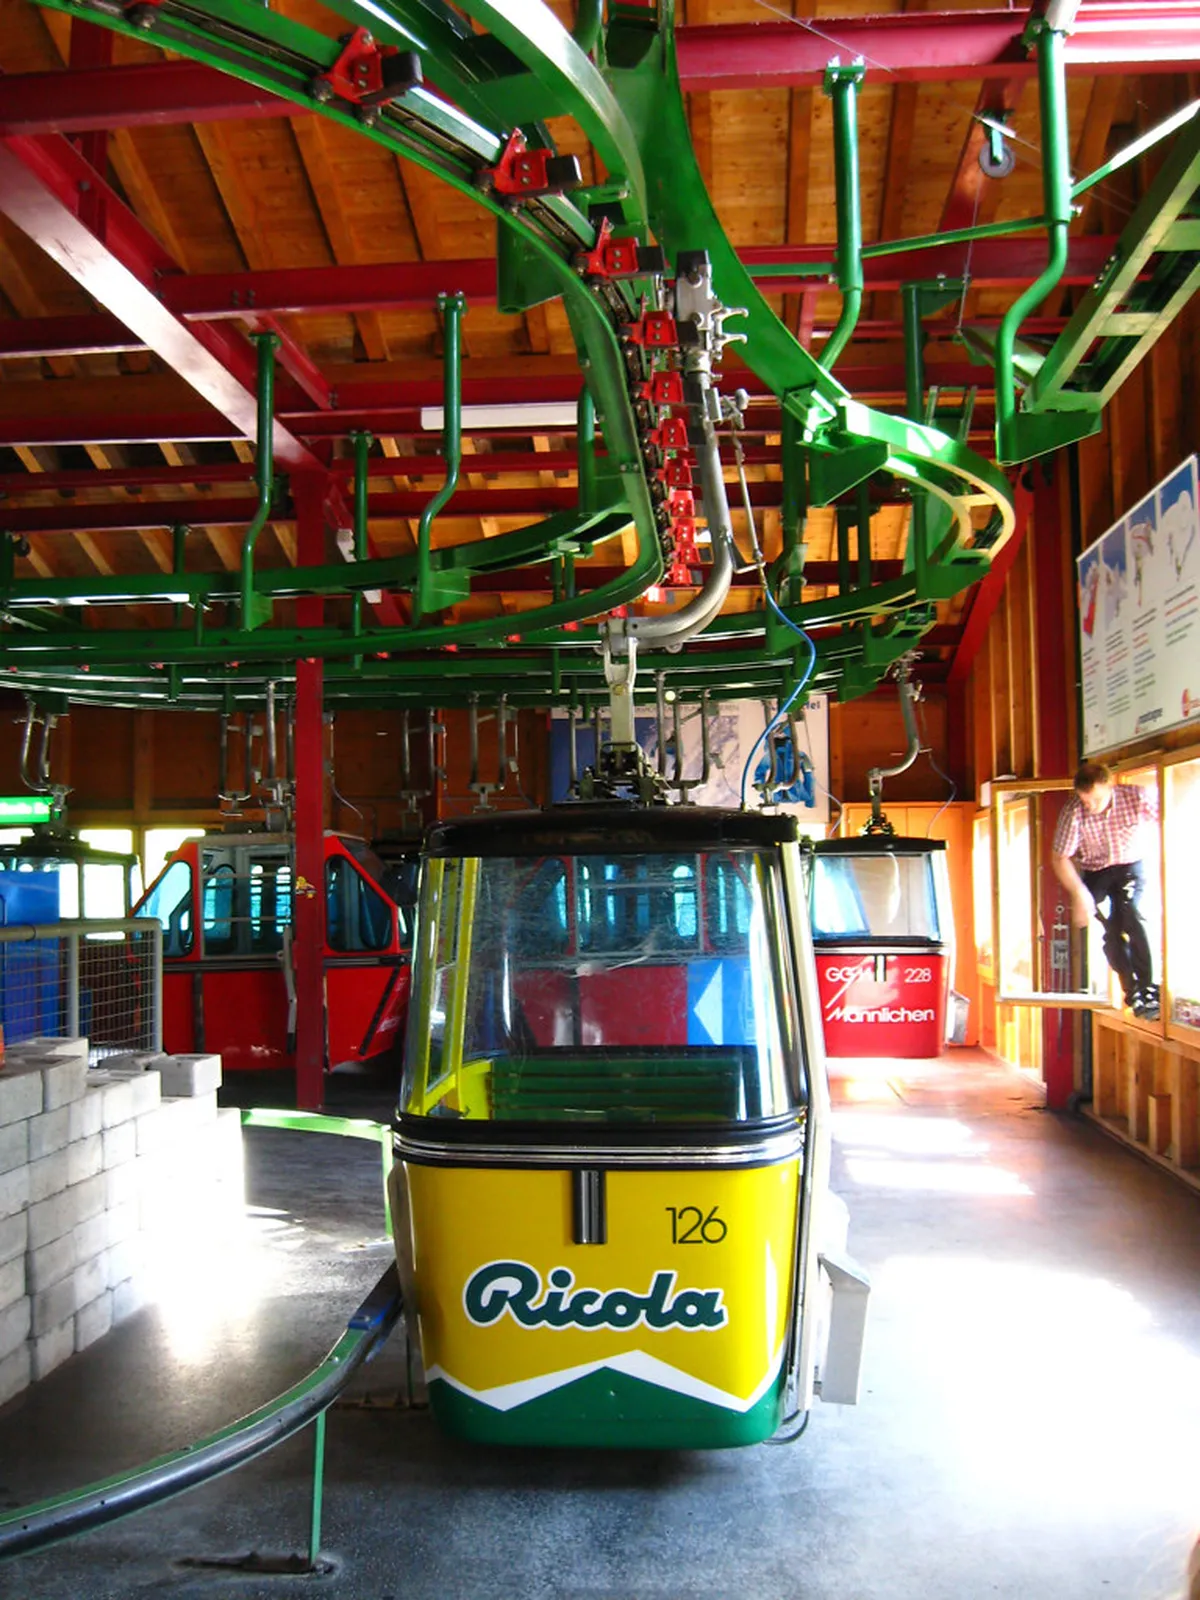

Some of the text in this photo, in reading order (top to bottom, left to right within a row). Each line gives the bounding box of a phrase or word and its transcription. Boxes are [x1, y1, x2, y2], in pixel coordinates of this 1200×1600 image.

[903, 967, 932, 983] 228
[665, 1205, 728, 1244] 126
[463, 1259, 729, 1332] Ricola
